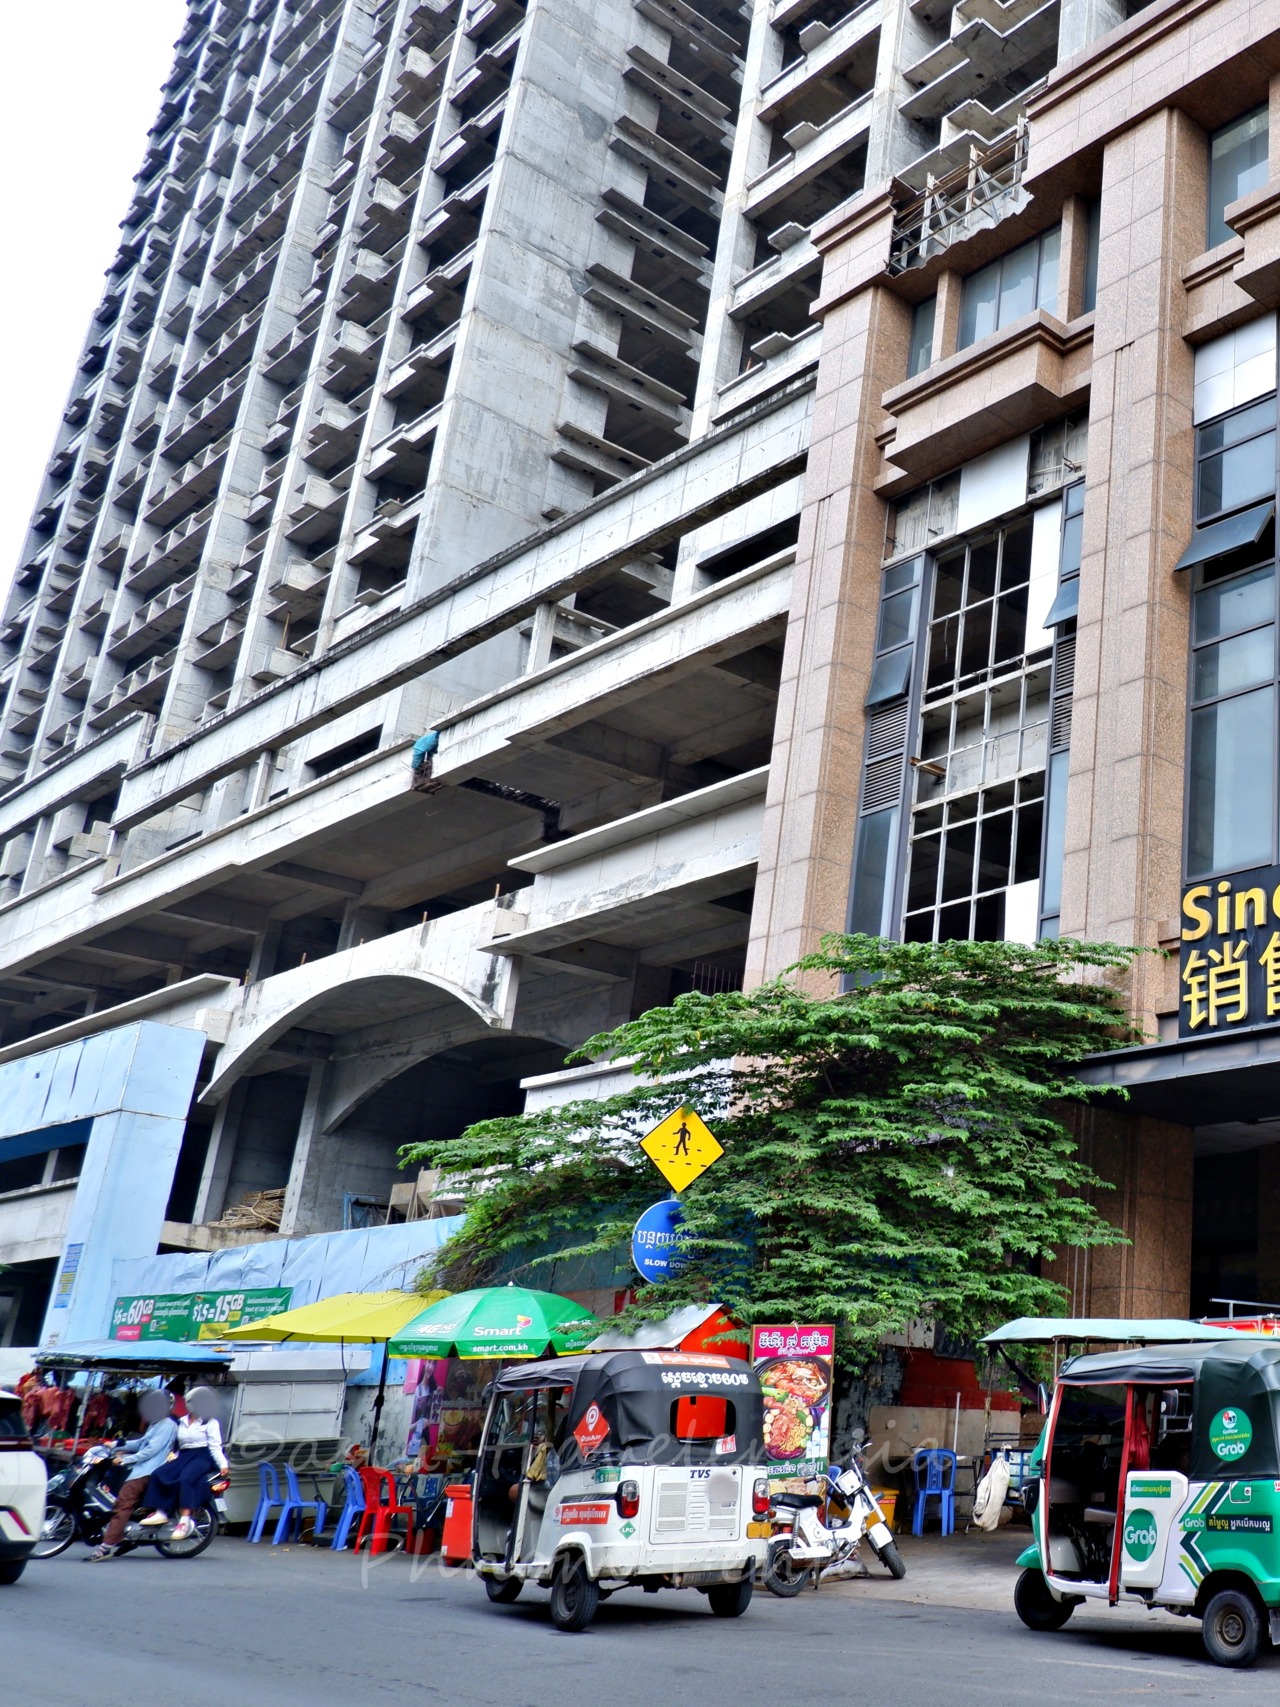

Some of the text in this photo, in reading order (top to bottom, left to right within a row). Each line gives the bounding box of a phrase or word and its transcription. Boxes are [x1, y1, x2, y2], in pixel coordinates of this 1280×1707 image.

[644, 1258, 668, 1267] SLOW
[473, 1326, 522, 1336] Smart
[472, 1343, 528, 1352] smart.com.kh
[1217, 1441, 1245, 1456] Grab
[689, 1469, 711, 1479] TVS
[1185, 1518, 1205, 1528] Grab
[1124, 1526, 1157, 1545] Grab
